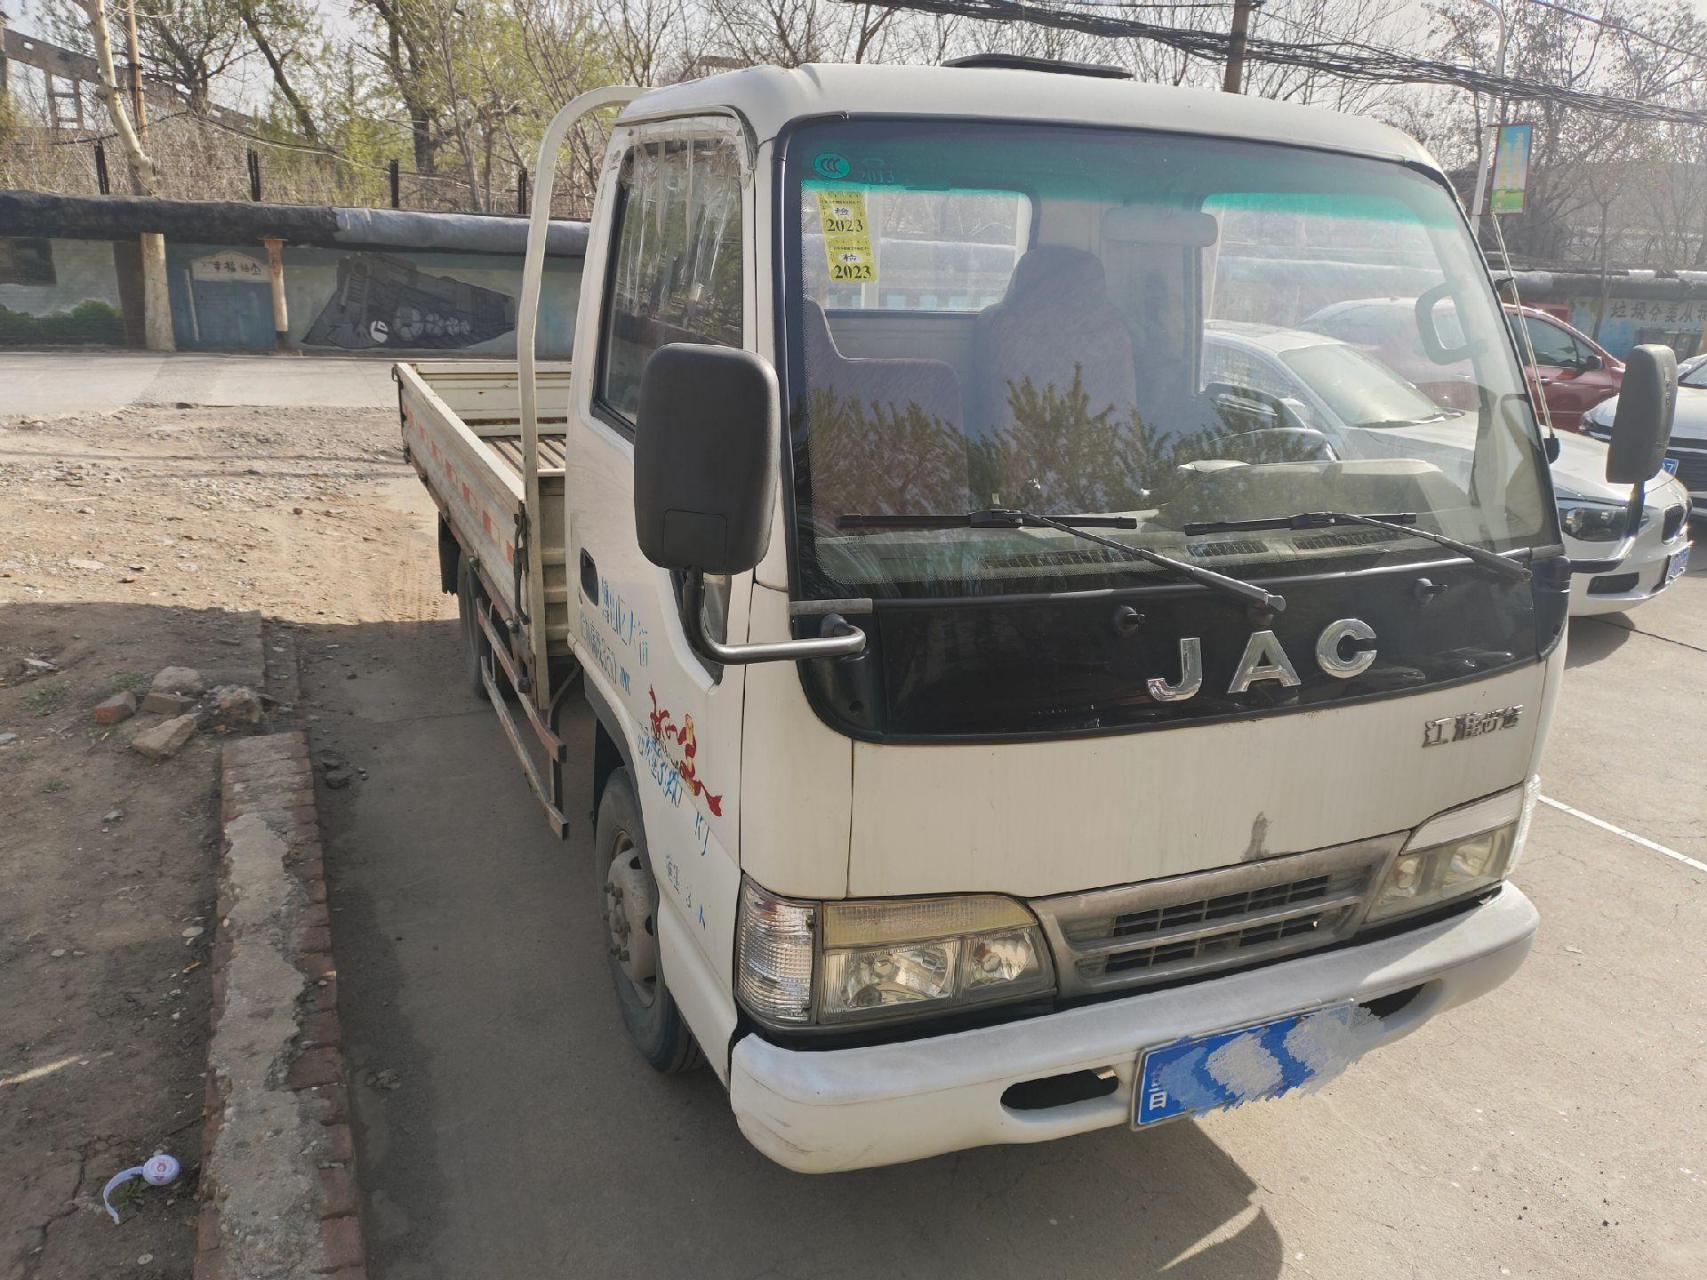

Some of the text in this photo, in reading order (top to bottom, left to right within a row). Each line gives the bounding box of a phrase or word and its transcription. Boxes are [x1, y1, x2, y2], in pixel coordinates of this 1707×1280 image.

[826, 218, 864, 233] 2023
[834, 264, 872, 279] 2023
[1147, 617, 1378, 702] JAC
